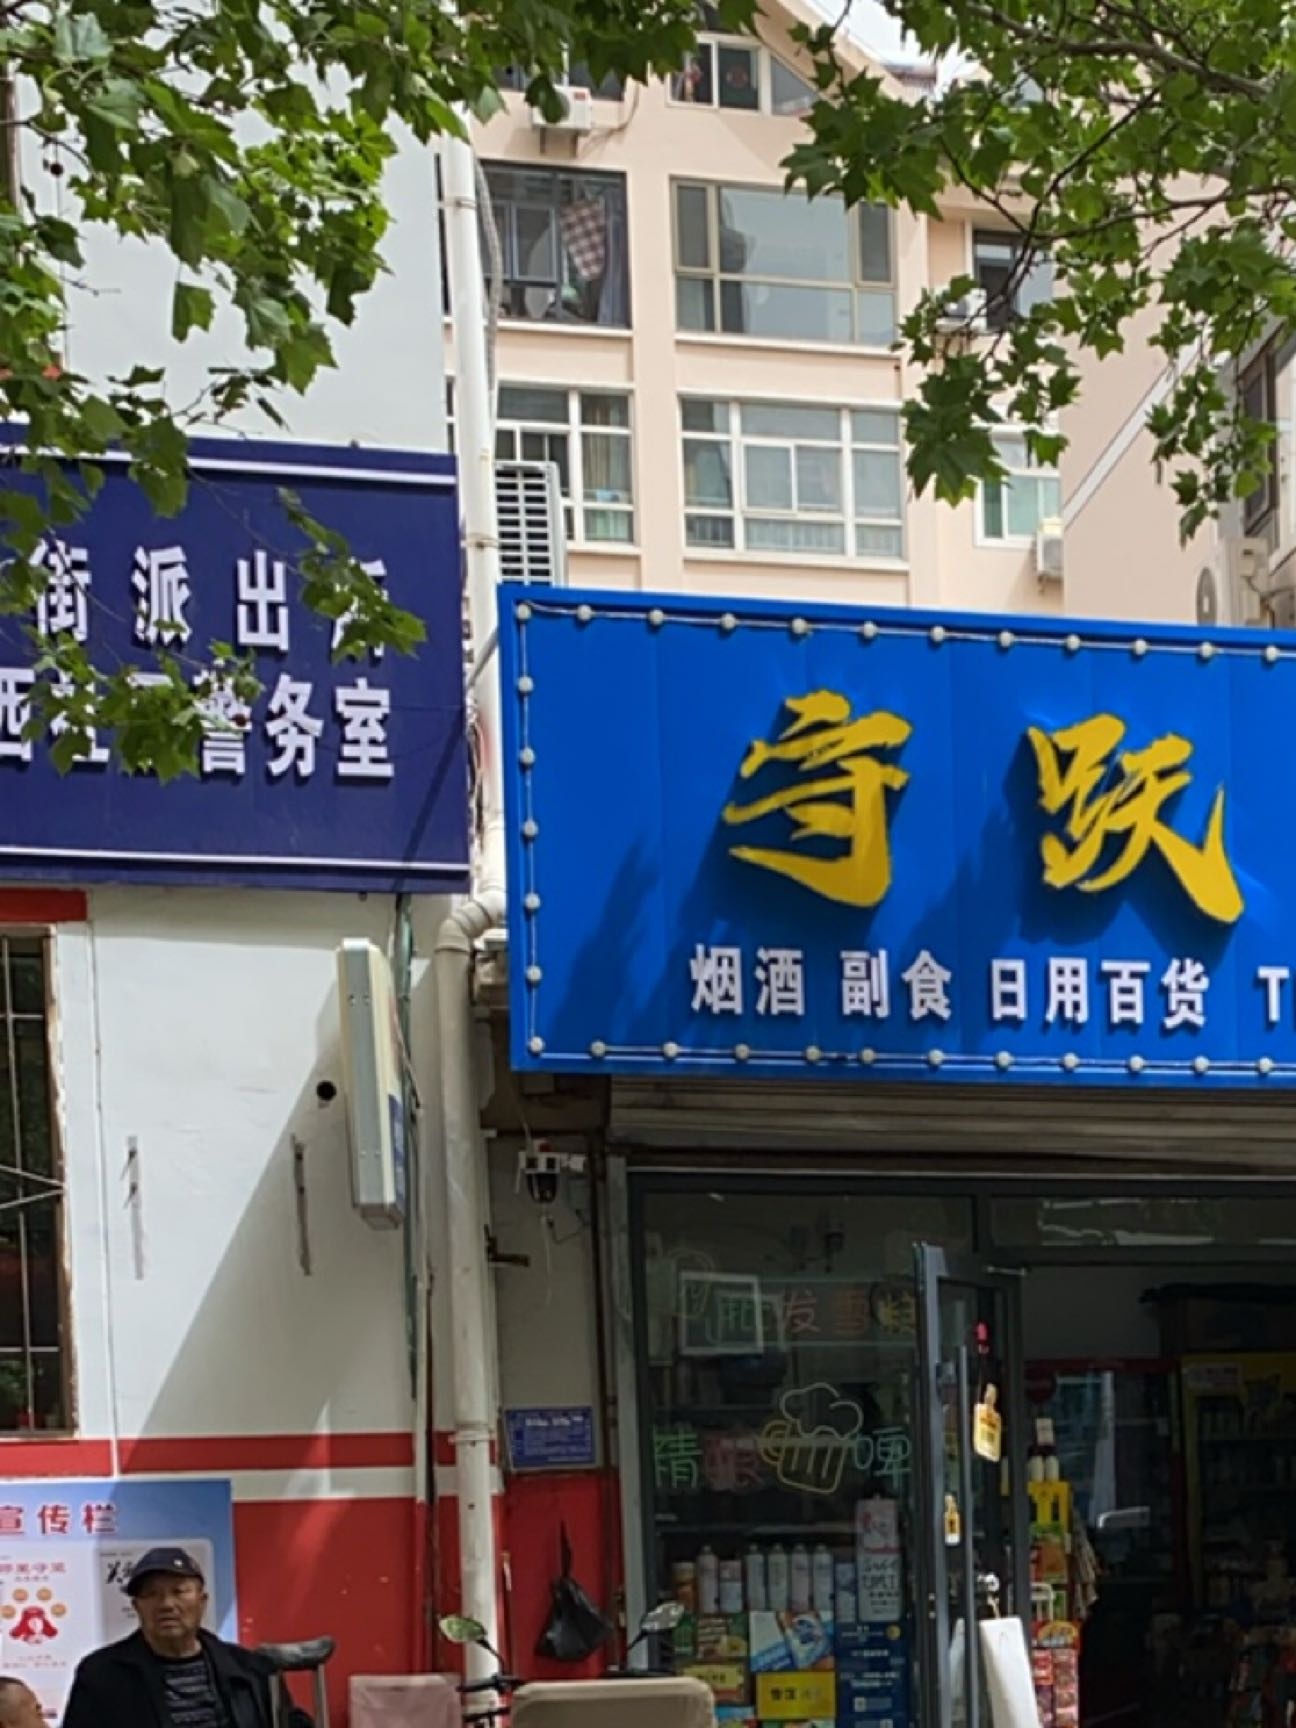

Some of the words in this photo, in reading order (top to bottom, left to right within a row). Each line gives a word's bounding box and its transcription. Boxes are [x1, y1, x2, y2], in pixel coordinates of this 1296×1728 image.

[0, 667, 395, 779] 西警务室
[690, 944, 805, 1016] 烟酒
[840, 948, 952, 1021] 副食
[991, 956, 1209, 1029] 日用百货
[0, 1503, 118, 1536] 宣传栏
